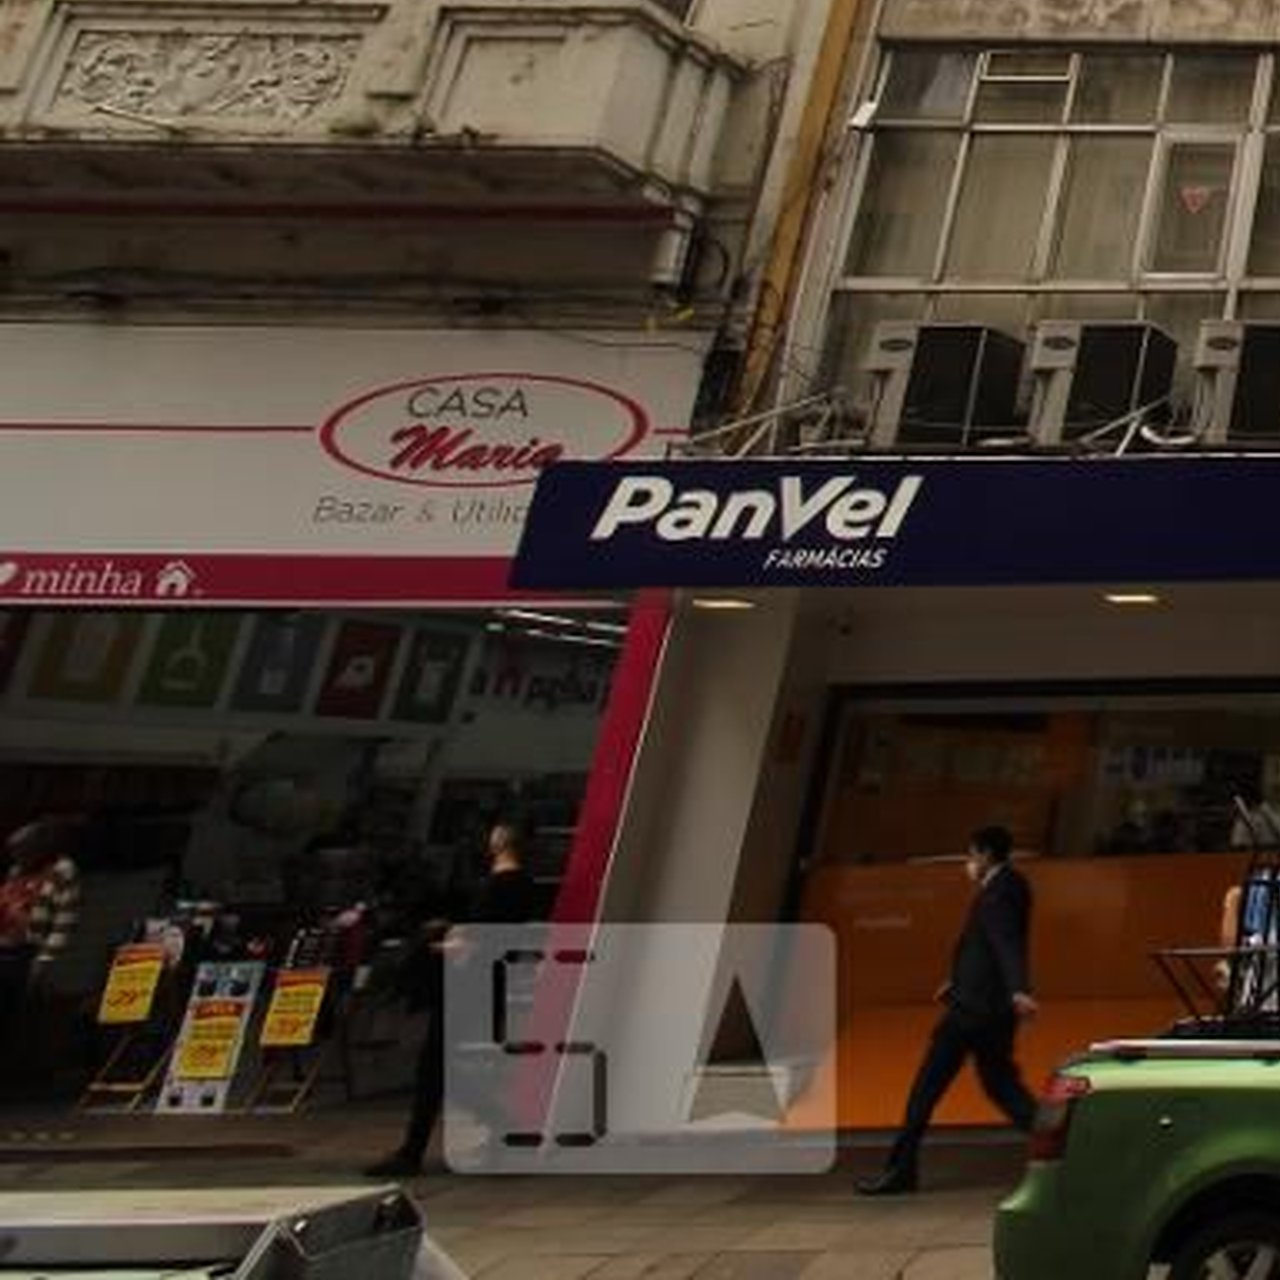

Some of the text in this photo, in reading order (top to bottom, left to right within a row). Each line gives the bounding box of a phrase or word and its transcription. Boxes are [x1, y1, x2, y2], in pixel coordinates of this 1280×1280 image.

[407, 386, 529, 419] CASA
[388, 422, 563, 471] Maria
[313, 495, 402, 524] Bazar
[762, 546, 888, 570] FARMÁCIAS
[20, 560, 142, 595] minha
